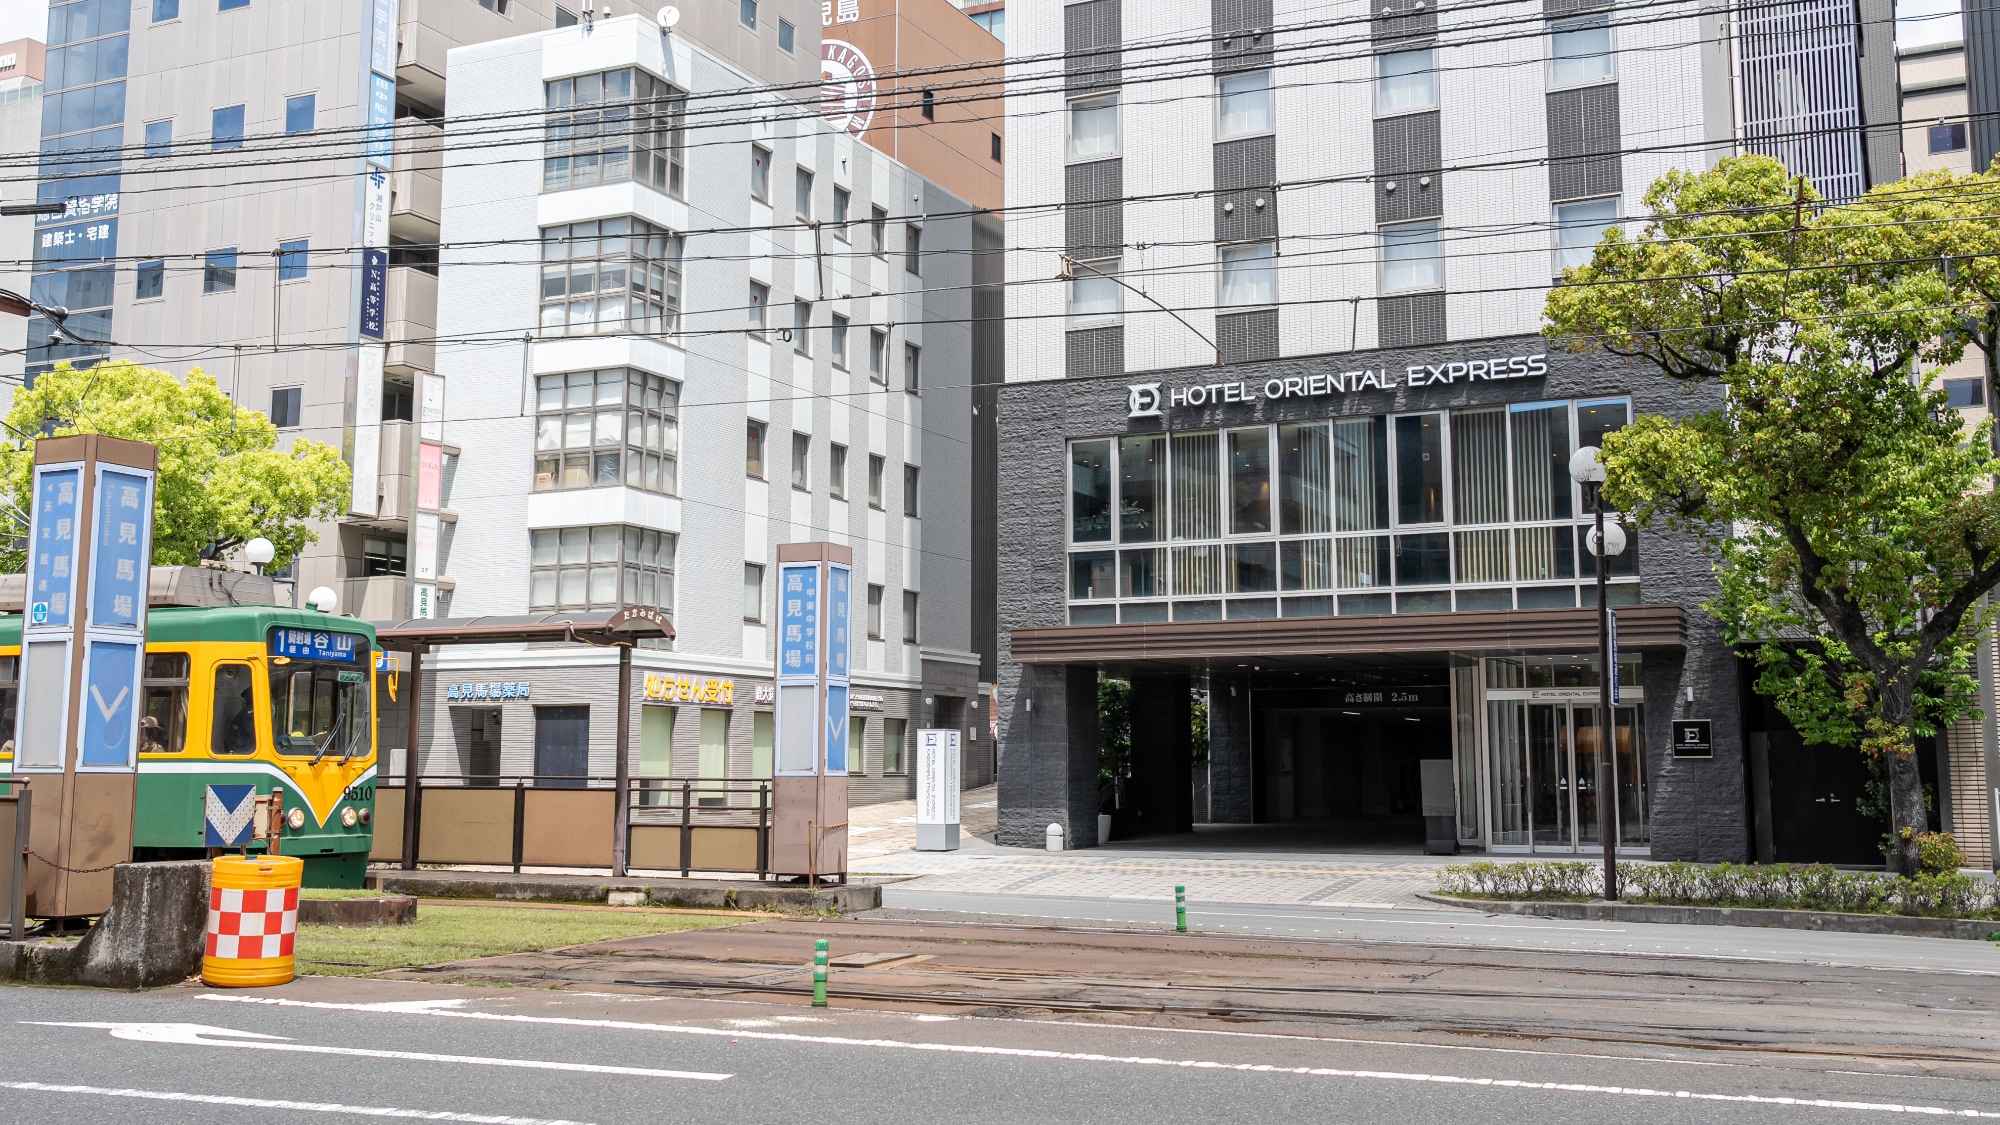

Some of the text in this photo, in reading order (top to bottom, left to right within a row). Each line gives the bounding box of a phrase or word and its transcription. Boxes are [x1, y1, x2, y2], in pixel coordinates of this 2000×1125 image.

[827, 44, 872, 132] KAGOSHIM
[41, 224, 110, 248] 建築士・宅建
[1170, 382, 1257, 407] HOTEL
[1264, 369, 1398, 399] ORIENTAL
[1406, 353, 1548, 387] EXPRESS
[50, 481, 76, 617] 高見馬場
[113, 484, 141, 618] 高見馬場
[785, 573, 804, 668] 高見馬場
[279, 629, 286, 653] 1
[313, 632, 353, 652] 谷山
[318, 649, 347, 658] Taniyama
[447, 681, 531, 700] 高見馬場薬局
[644, 673, 735, 704] 処方せん受付
[1345, 692, 1419, 703] 高さ制限 2.5m
[343, 785, 373, 801] 9510
